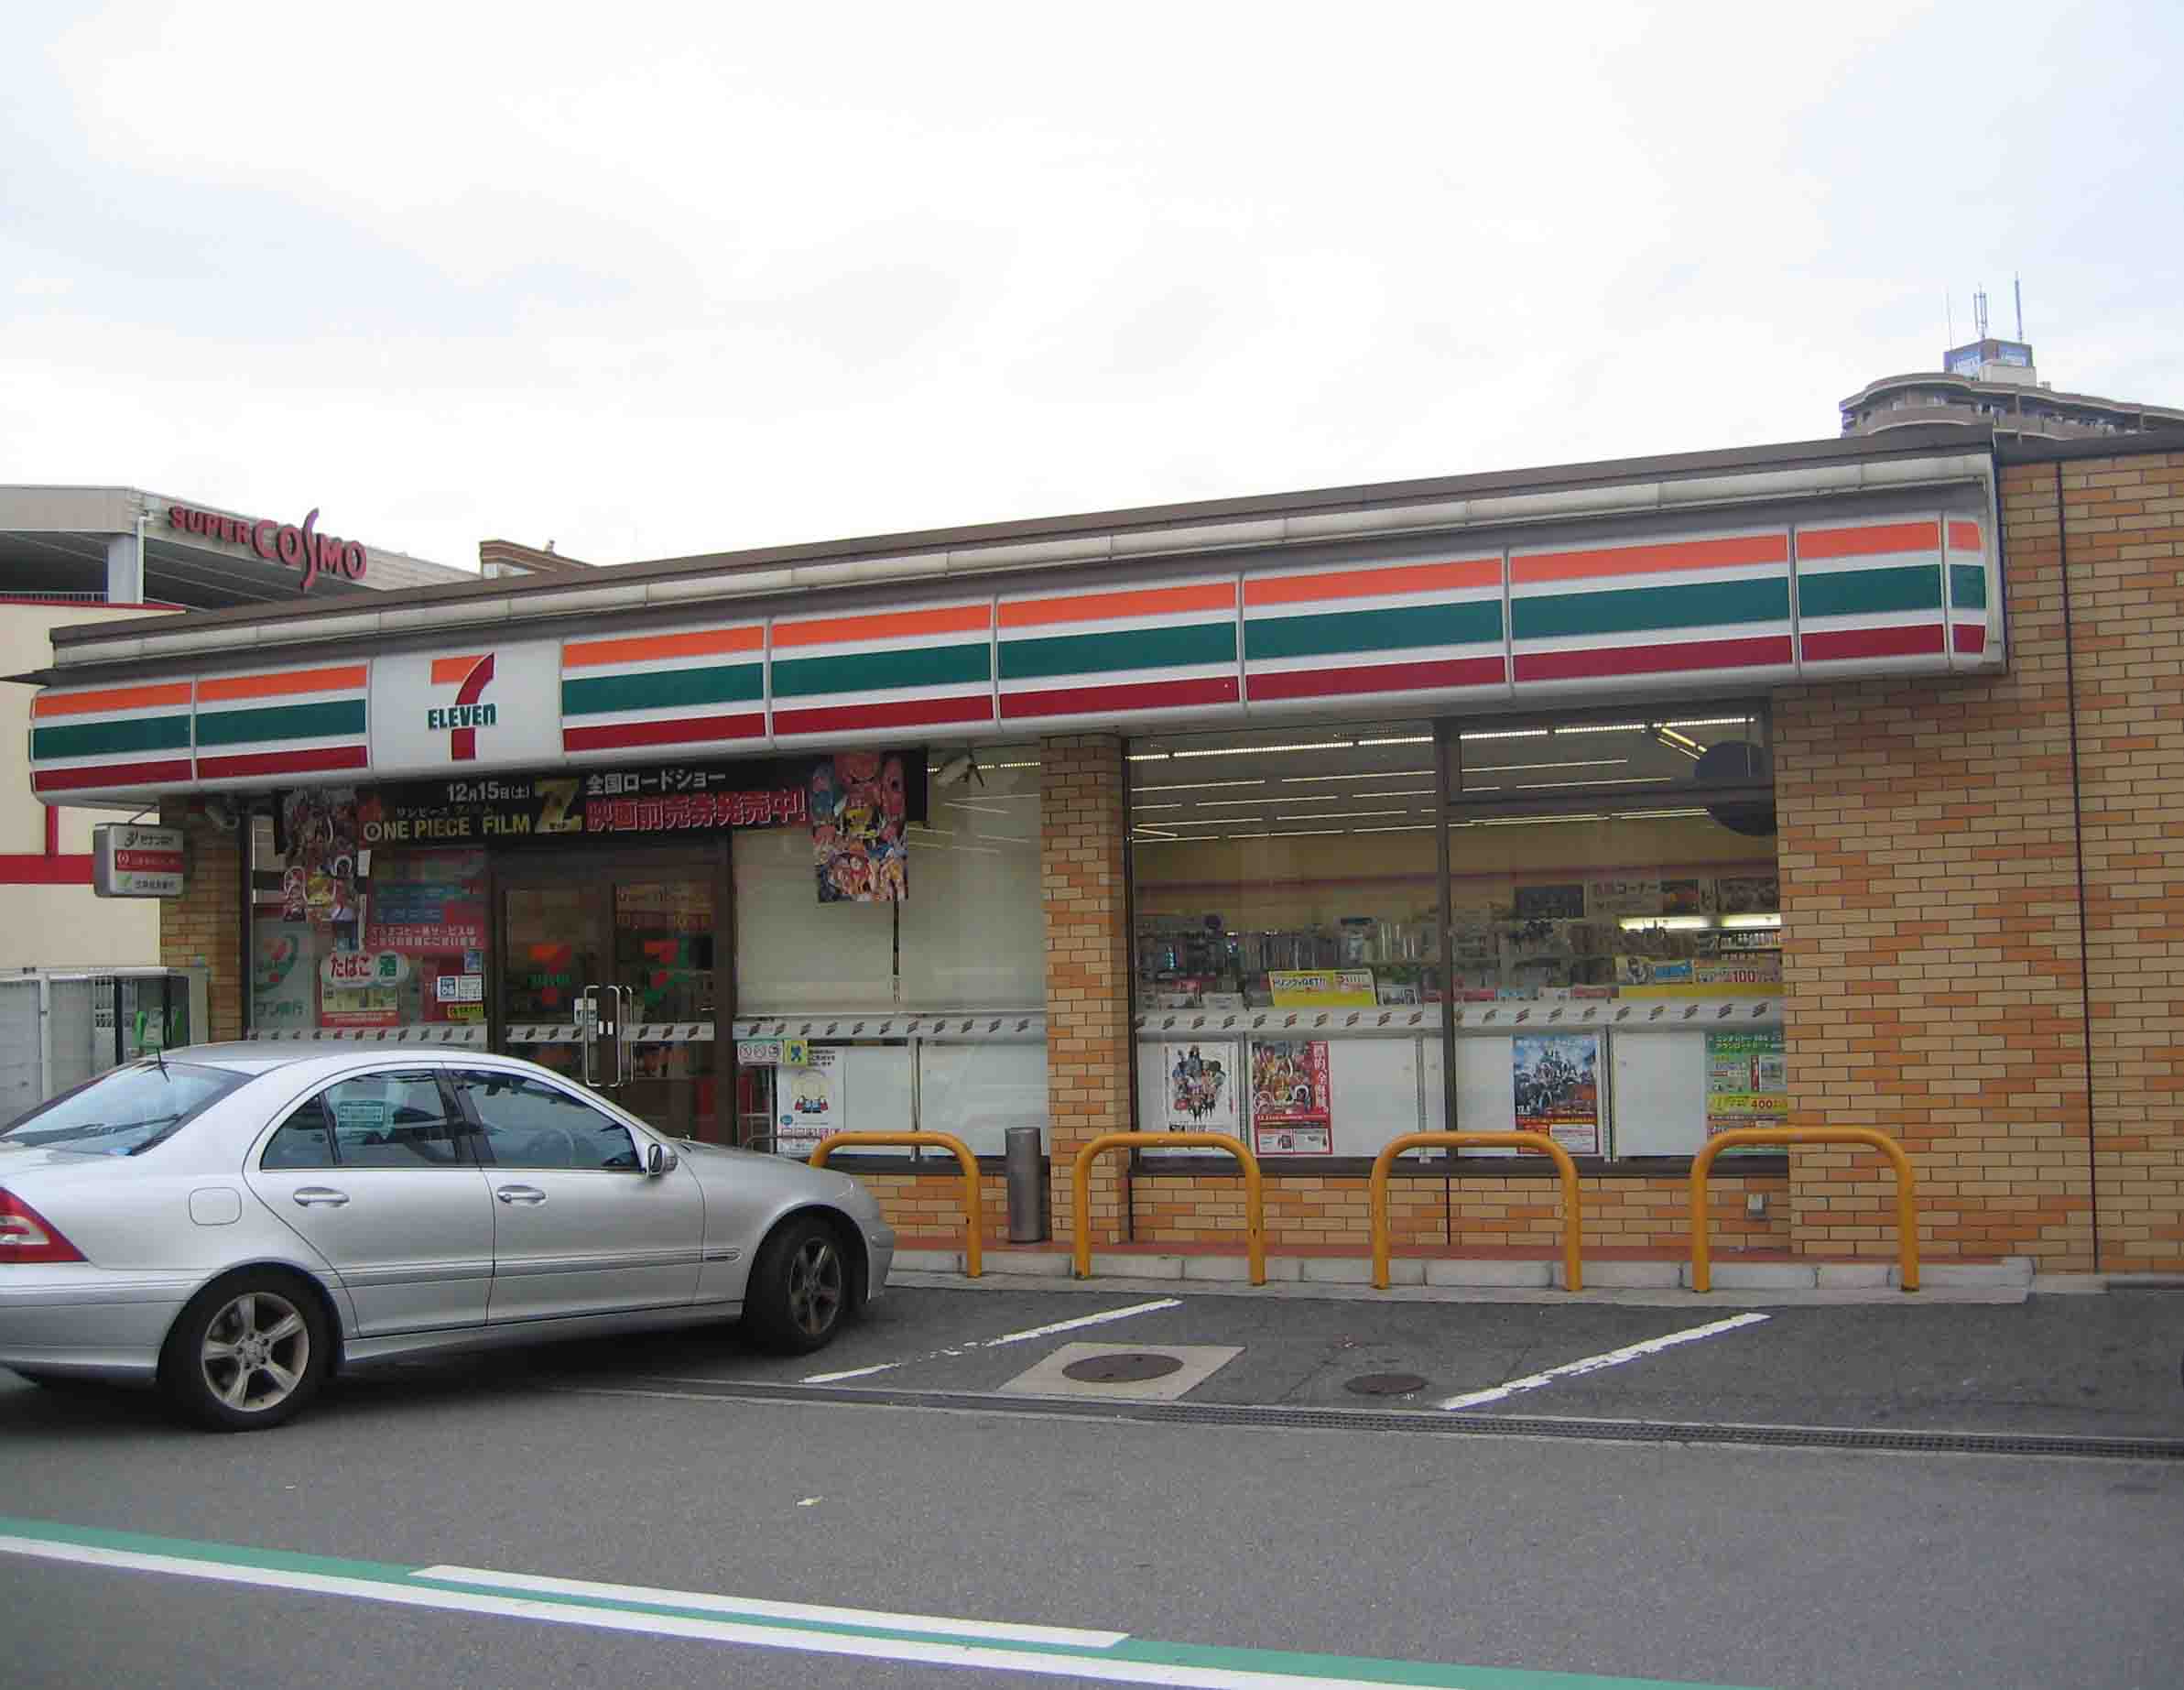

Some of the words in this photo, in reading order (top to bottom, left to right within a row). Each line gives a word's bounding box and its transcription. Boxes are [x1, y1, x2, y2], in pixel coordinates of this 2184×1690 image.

[168, 506, 251, 543] SUPER
[251, 507, 367, 594] COSMO
[430, 651, 495, 762] 7
[586, 769, 726, 795] 全国ロードショー
[364, 817, 410, 841] ONE
[415, 815, 471, 837] PIECE
[483, 812, 530, 834] FILM
